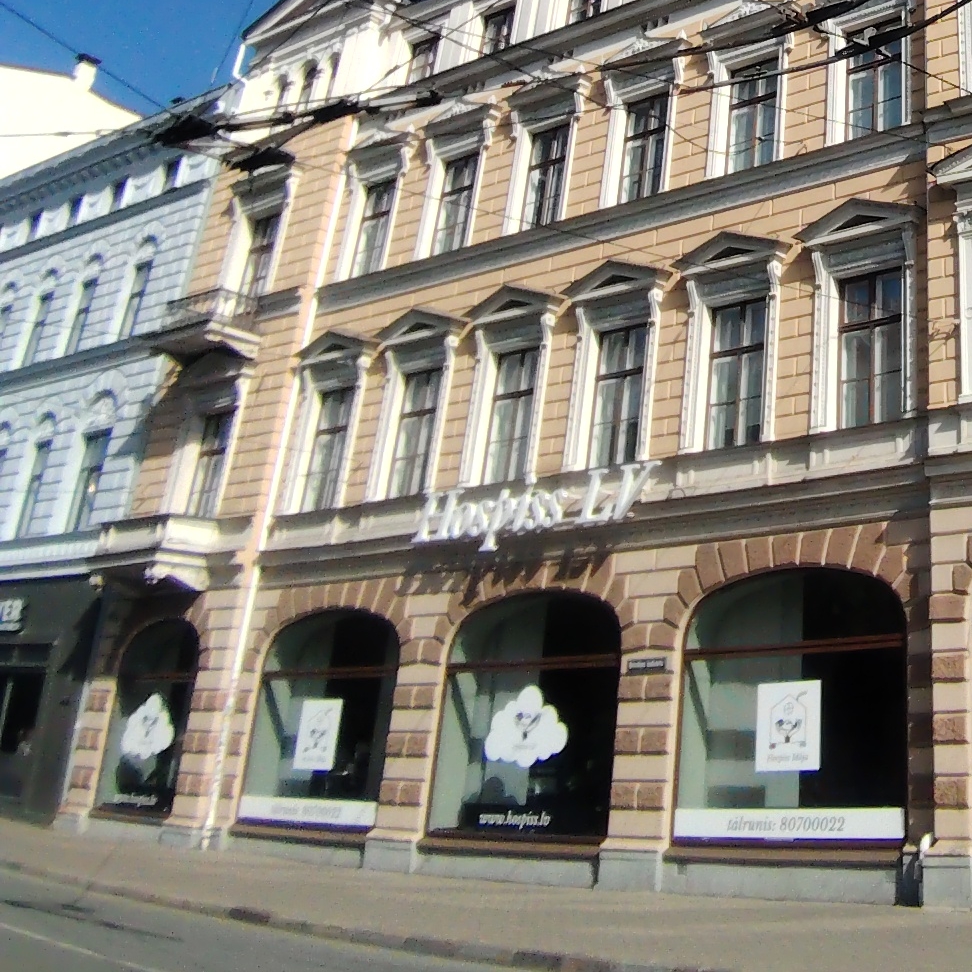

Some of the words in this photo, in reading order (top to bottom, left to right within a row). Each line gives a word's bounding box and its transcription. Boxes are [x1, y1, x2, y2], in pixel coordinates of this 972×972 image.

[410, 486, 568, 552] Hospiss
[575, 460, 663, 524] LV
[779, 816, 845, 832] 80700022
